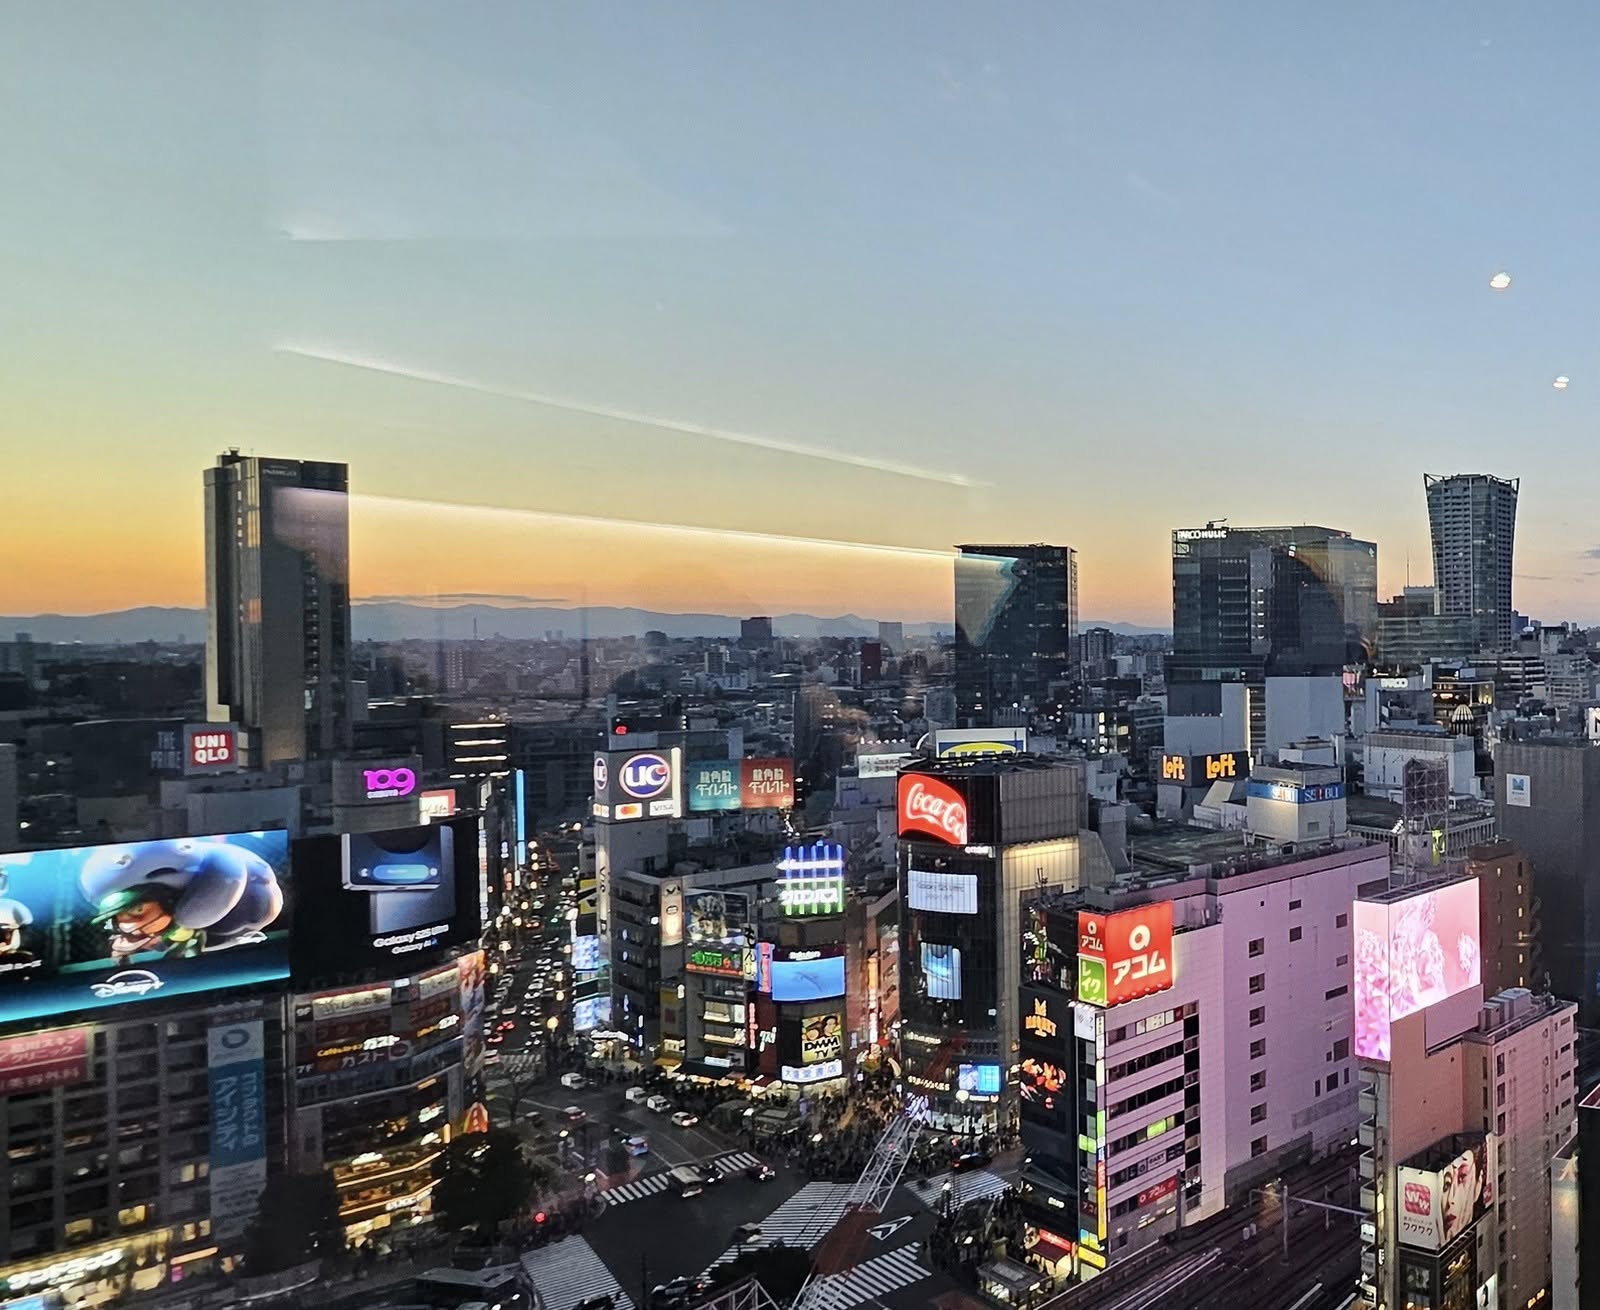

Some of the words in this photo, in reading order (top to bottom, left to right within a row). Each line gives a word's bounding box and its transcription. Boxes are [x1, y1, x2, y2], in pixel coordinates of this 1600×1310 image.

[194, 734, 226, 749] UNI
[194, 747, 229, 764] QLO
[363, 767, 416, 796] 109
[625, 763, 667, 788] UC
[1081, 934, 1104, 951] アコム
[1112, 950, 1167, 986] アコム
[804, 1036, 839, 1051] DMM
[342, 1052, 385, 1069] ガスト
[1403, 1221, 1433, 1236] ワクワク
